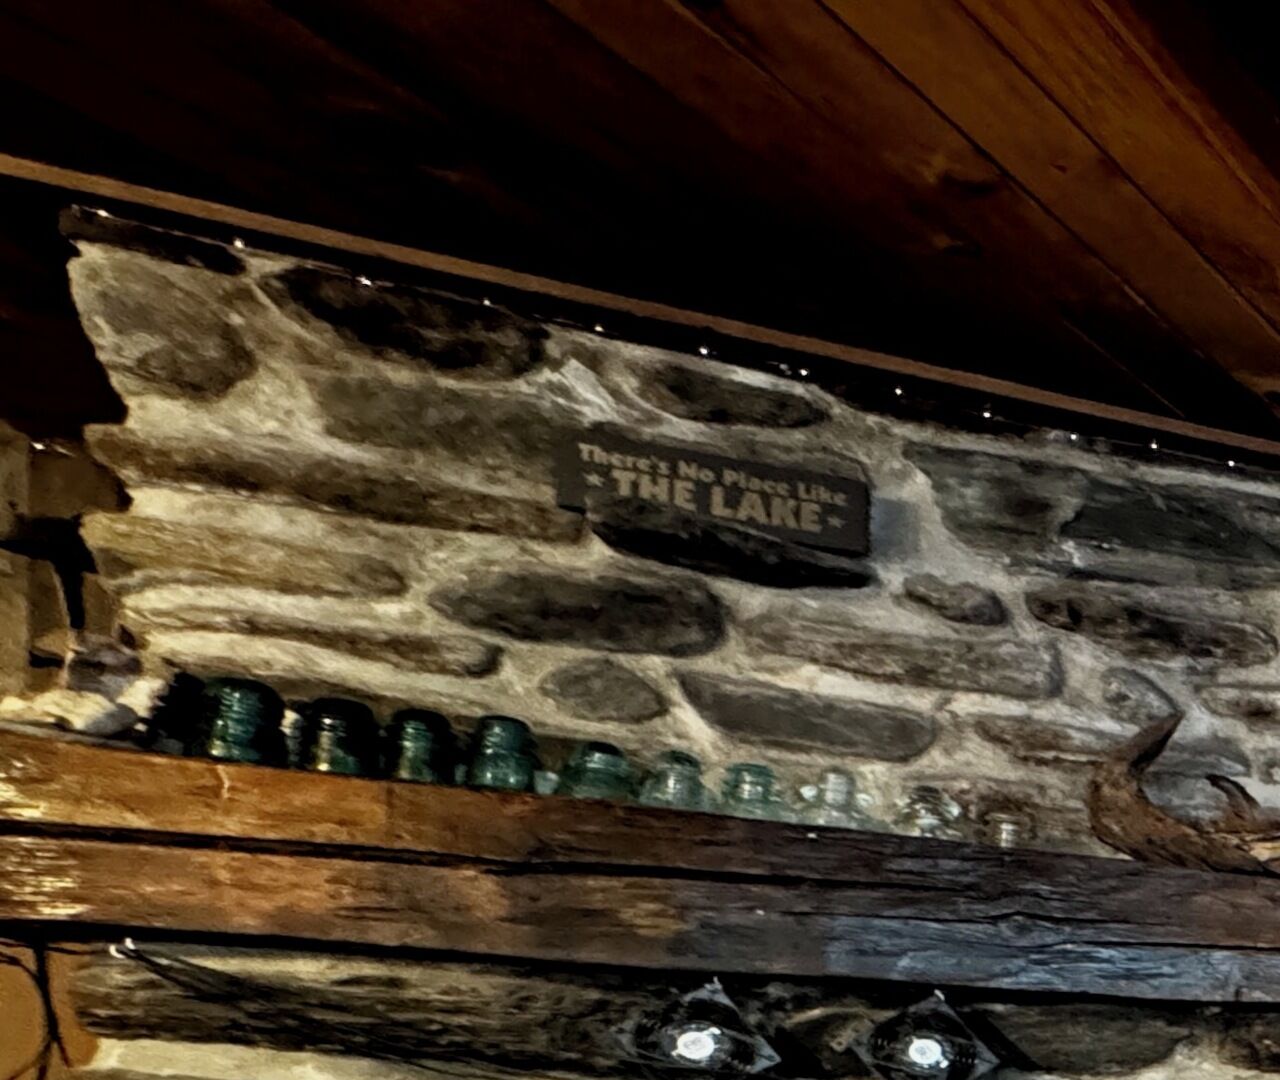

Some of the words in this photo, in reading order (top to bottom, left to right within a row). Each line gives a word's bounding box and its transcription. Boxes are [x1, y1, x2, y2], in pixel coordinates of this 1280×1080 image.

[578, 442, 671, 475] There's
[677, 459, 715, 483] No
[722, 466, 791, 497] Place
[797, 482, 848, 506] Like
[611, 468, 697, 511] THE
[709, 485, 823, 534] LAKE
